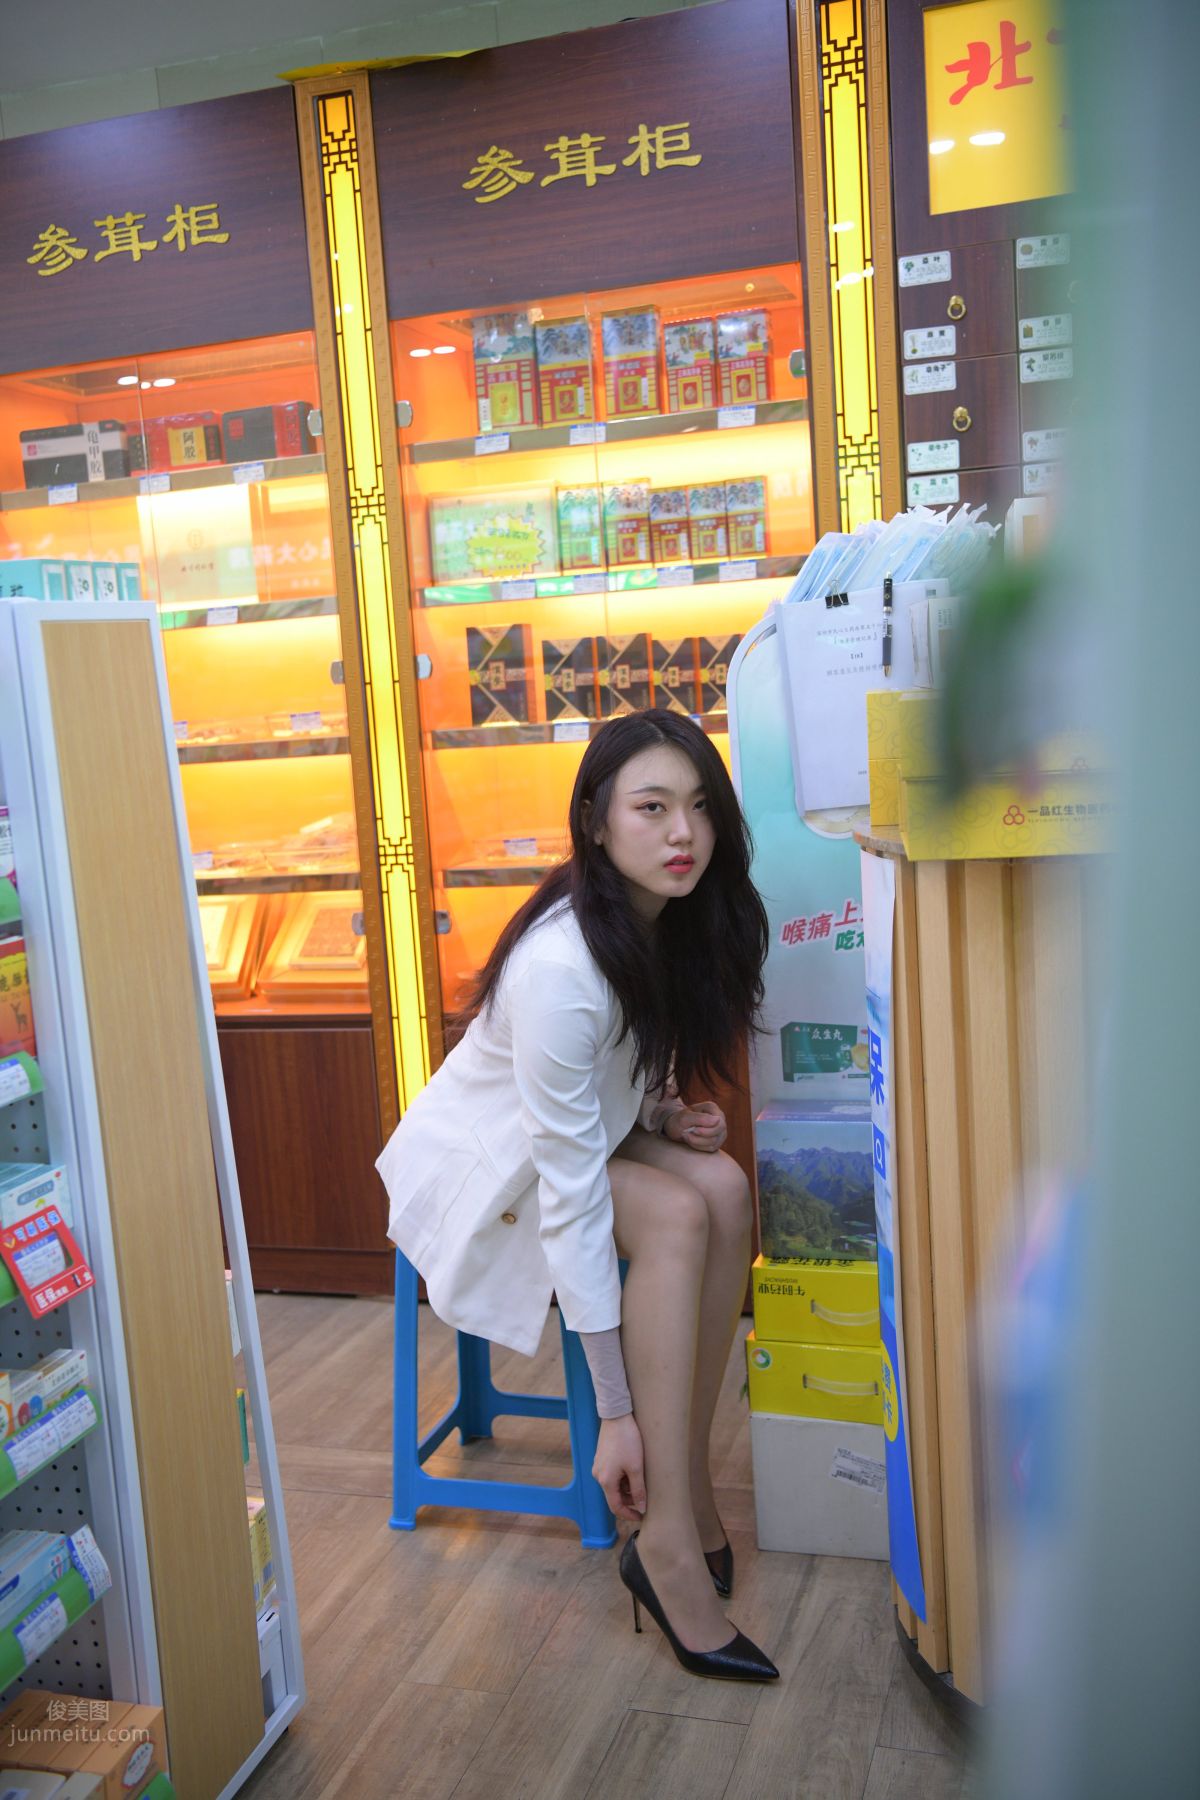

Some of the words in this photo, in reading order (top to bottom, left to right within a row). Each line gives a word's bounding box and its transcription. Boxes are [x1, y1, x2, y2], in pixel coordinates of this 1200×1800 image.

[462, 121, 702, 203] 参茸柜
[27, 203, 230, 277] 参茸柜
[781, 901, 864, 946] 喉痛上
